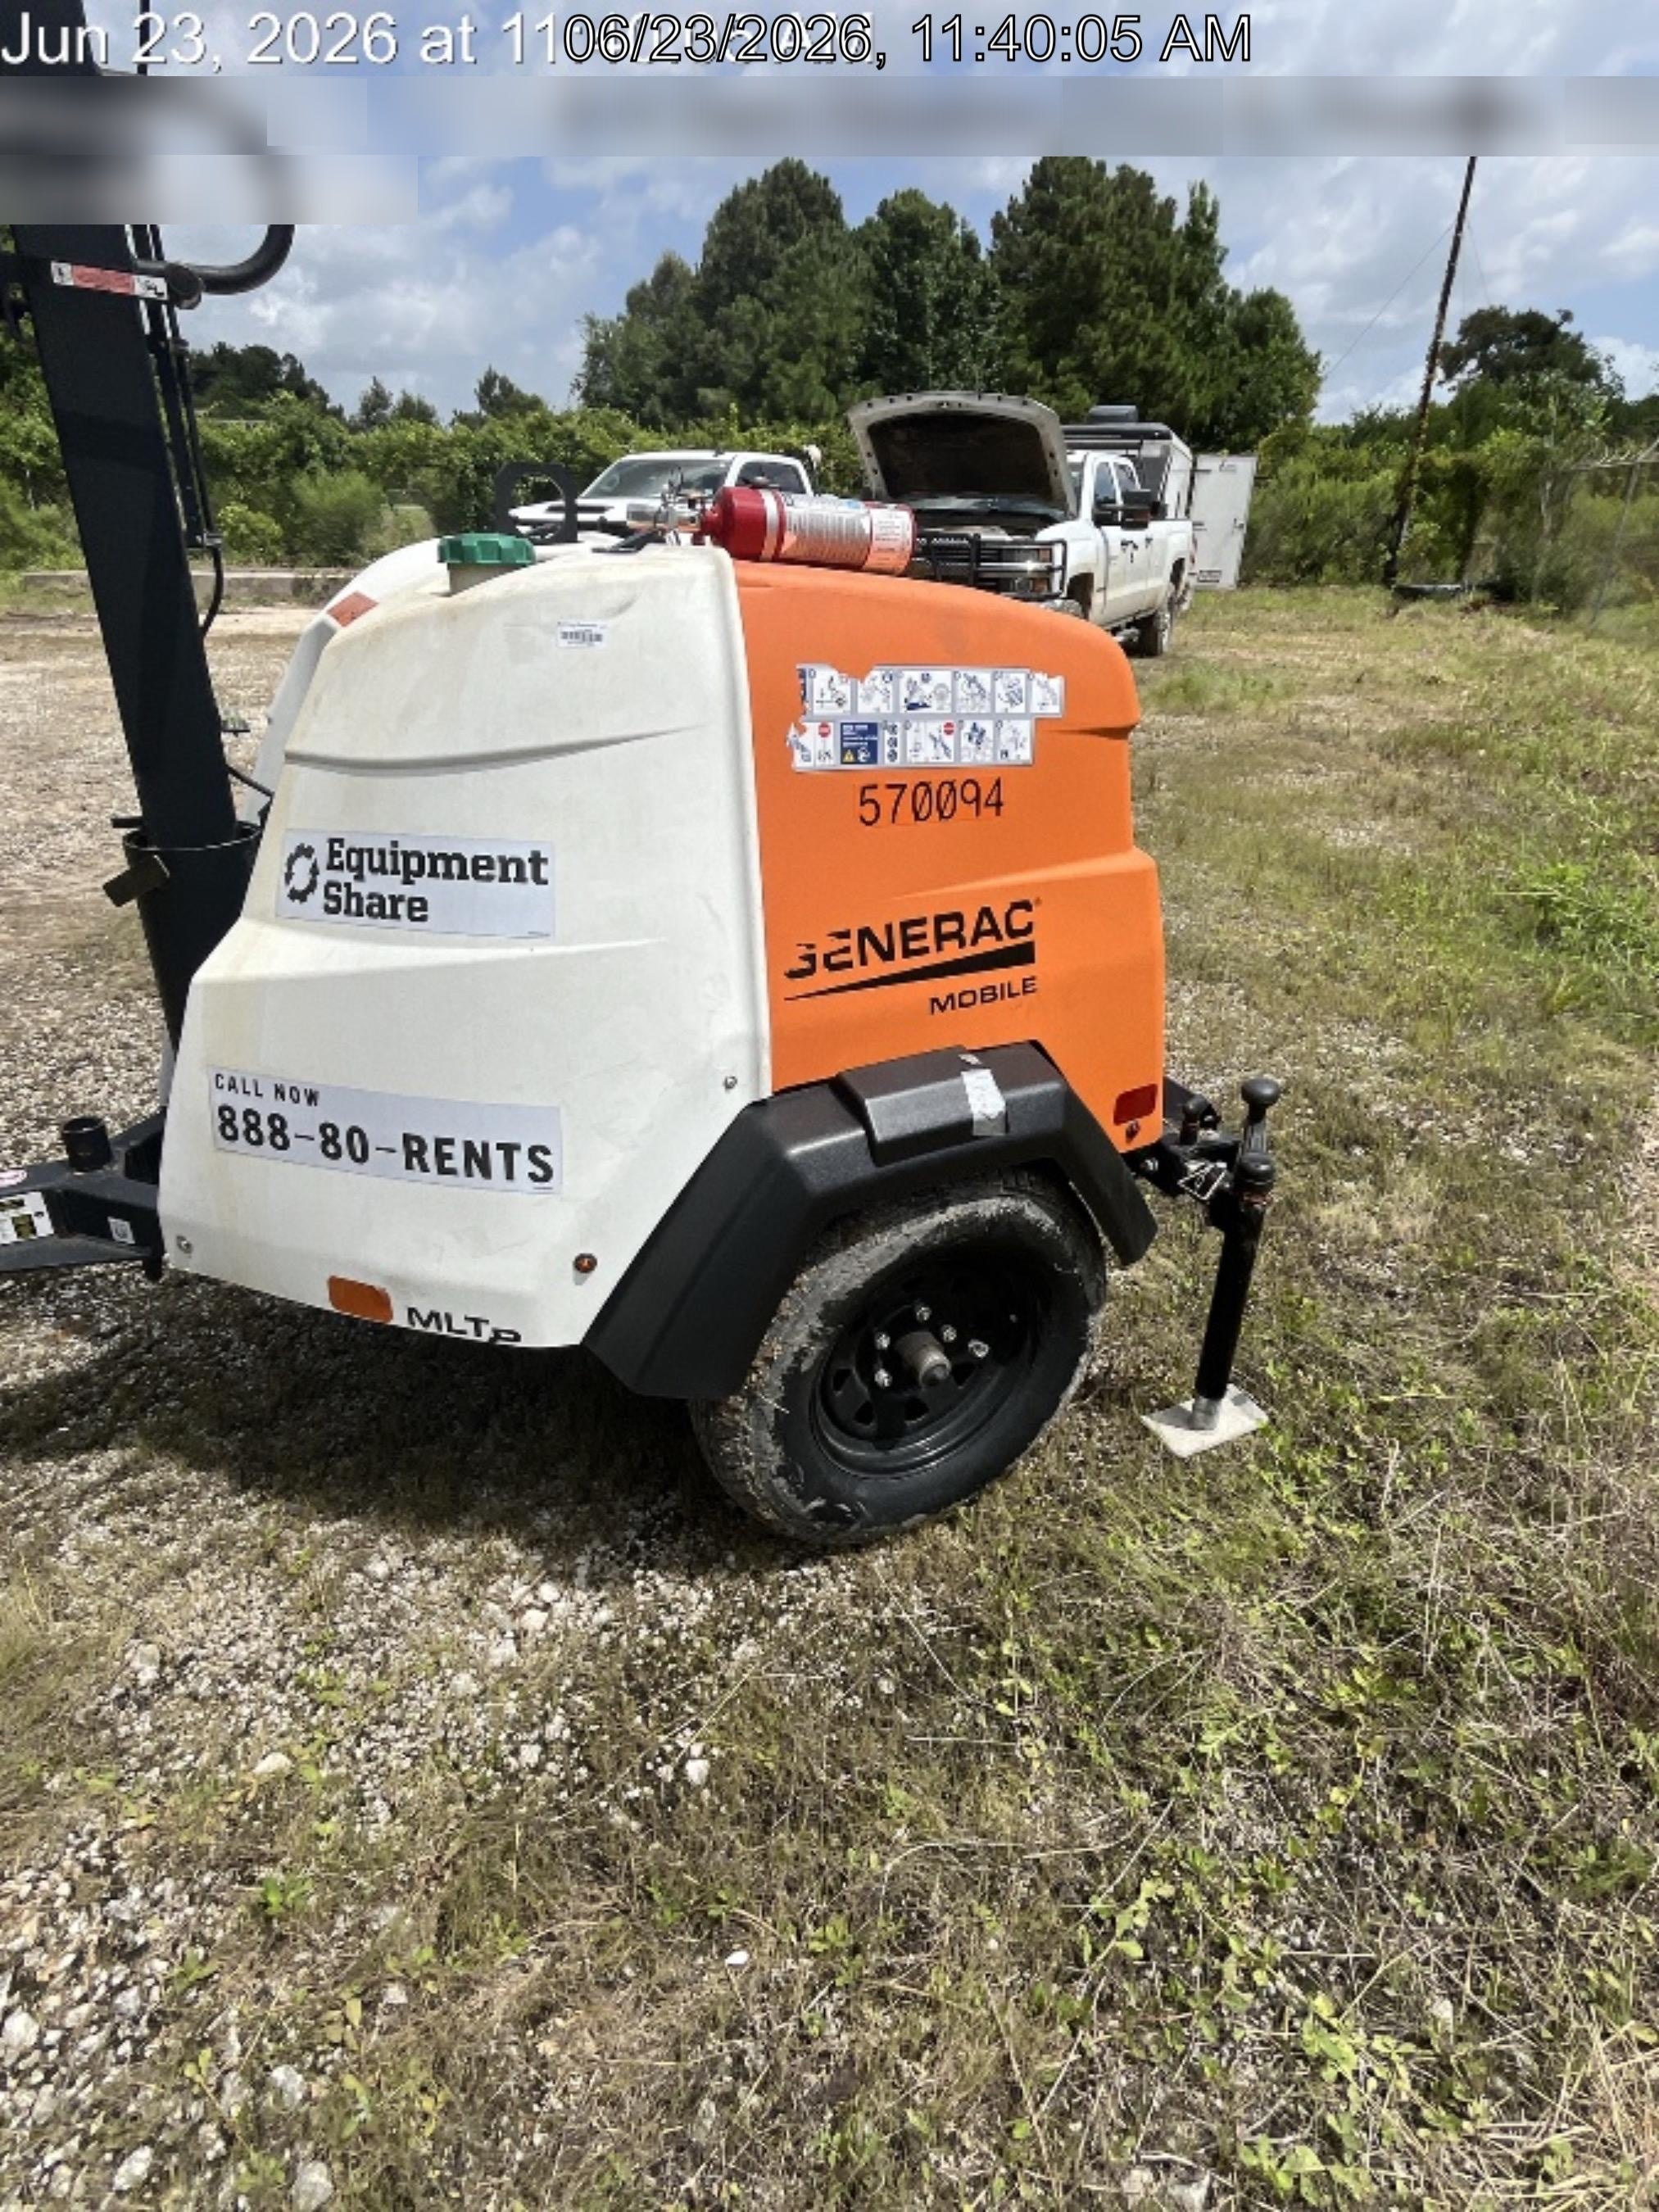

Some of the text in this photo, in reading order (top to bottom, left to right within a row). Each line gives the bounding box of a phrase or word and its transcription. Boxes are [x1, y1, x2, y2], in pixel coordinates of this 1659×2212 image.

[859, 777, 1004, 827] 570094
[326, 838, 549, 886] Equipment
[323, 881, 428, 922] Share
[929, 976, 1037, 1016] MOBILE
[215, 1073, 320, 1107] CALL NOW
[218, 1104, 554, 1184] 888-80-RENTS
